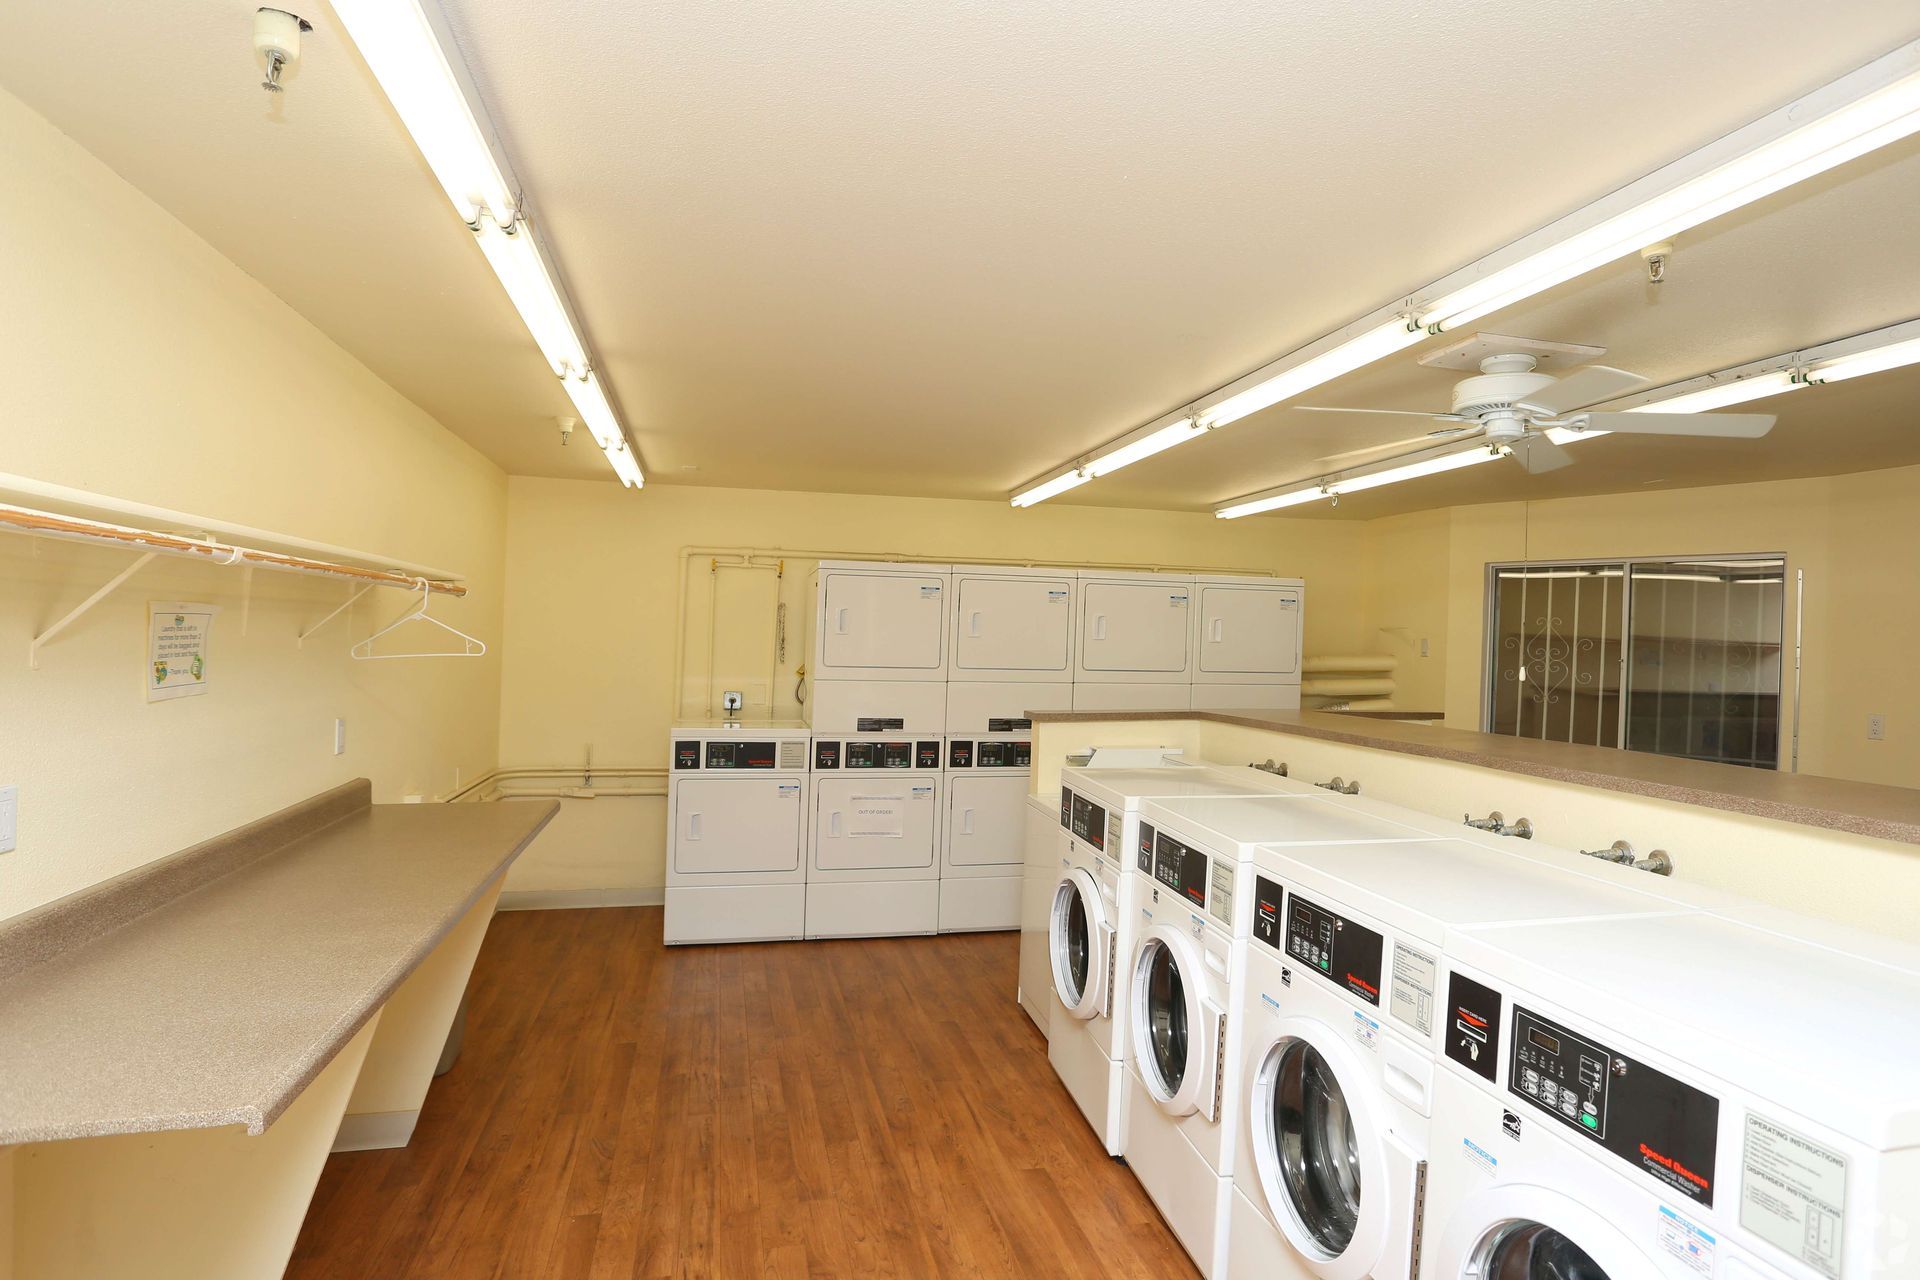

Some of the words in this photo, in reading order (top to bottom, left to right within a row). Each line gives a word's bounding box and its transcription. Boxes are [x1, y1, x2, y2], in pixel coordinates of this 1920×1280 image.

[1639, 1143, 1673, 1169] Speed
[1673, 1160, 1709, 1189] Queen
[1749, 1117, 1789, 1142] OPERATING
[1789, 1137, 1845, 1169] INSTRUCTIONS
[1643, 1156, 1678, 1181] Commercial
[1677, 1174, 1701, 1194] Washer
[1746, 1163, 1786, 1190] DISPENSER
[1785, 1184, 1842, 1219] INSTRUCTIONS
